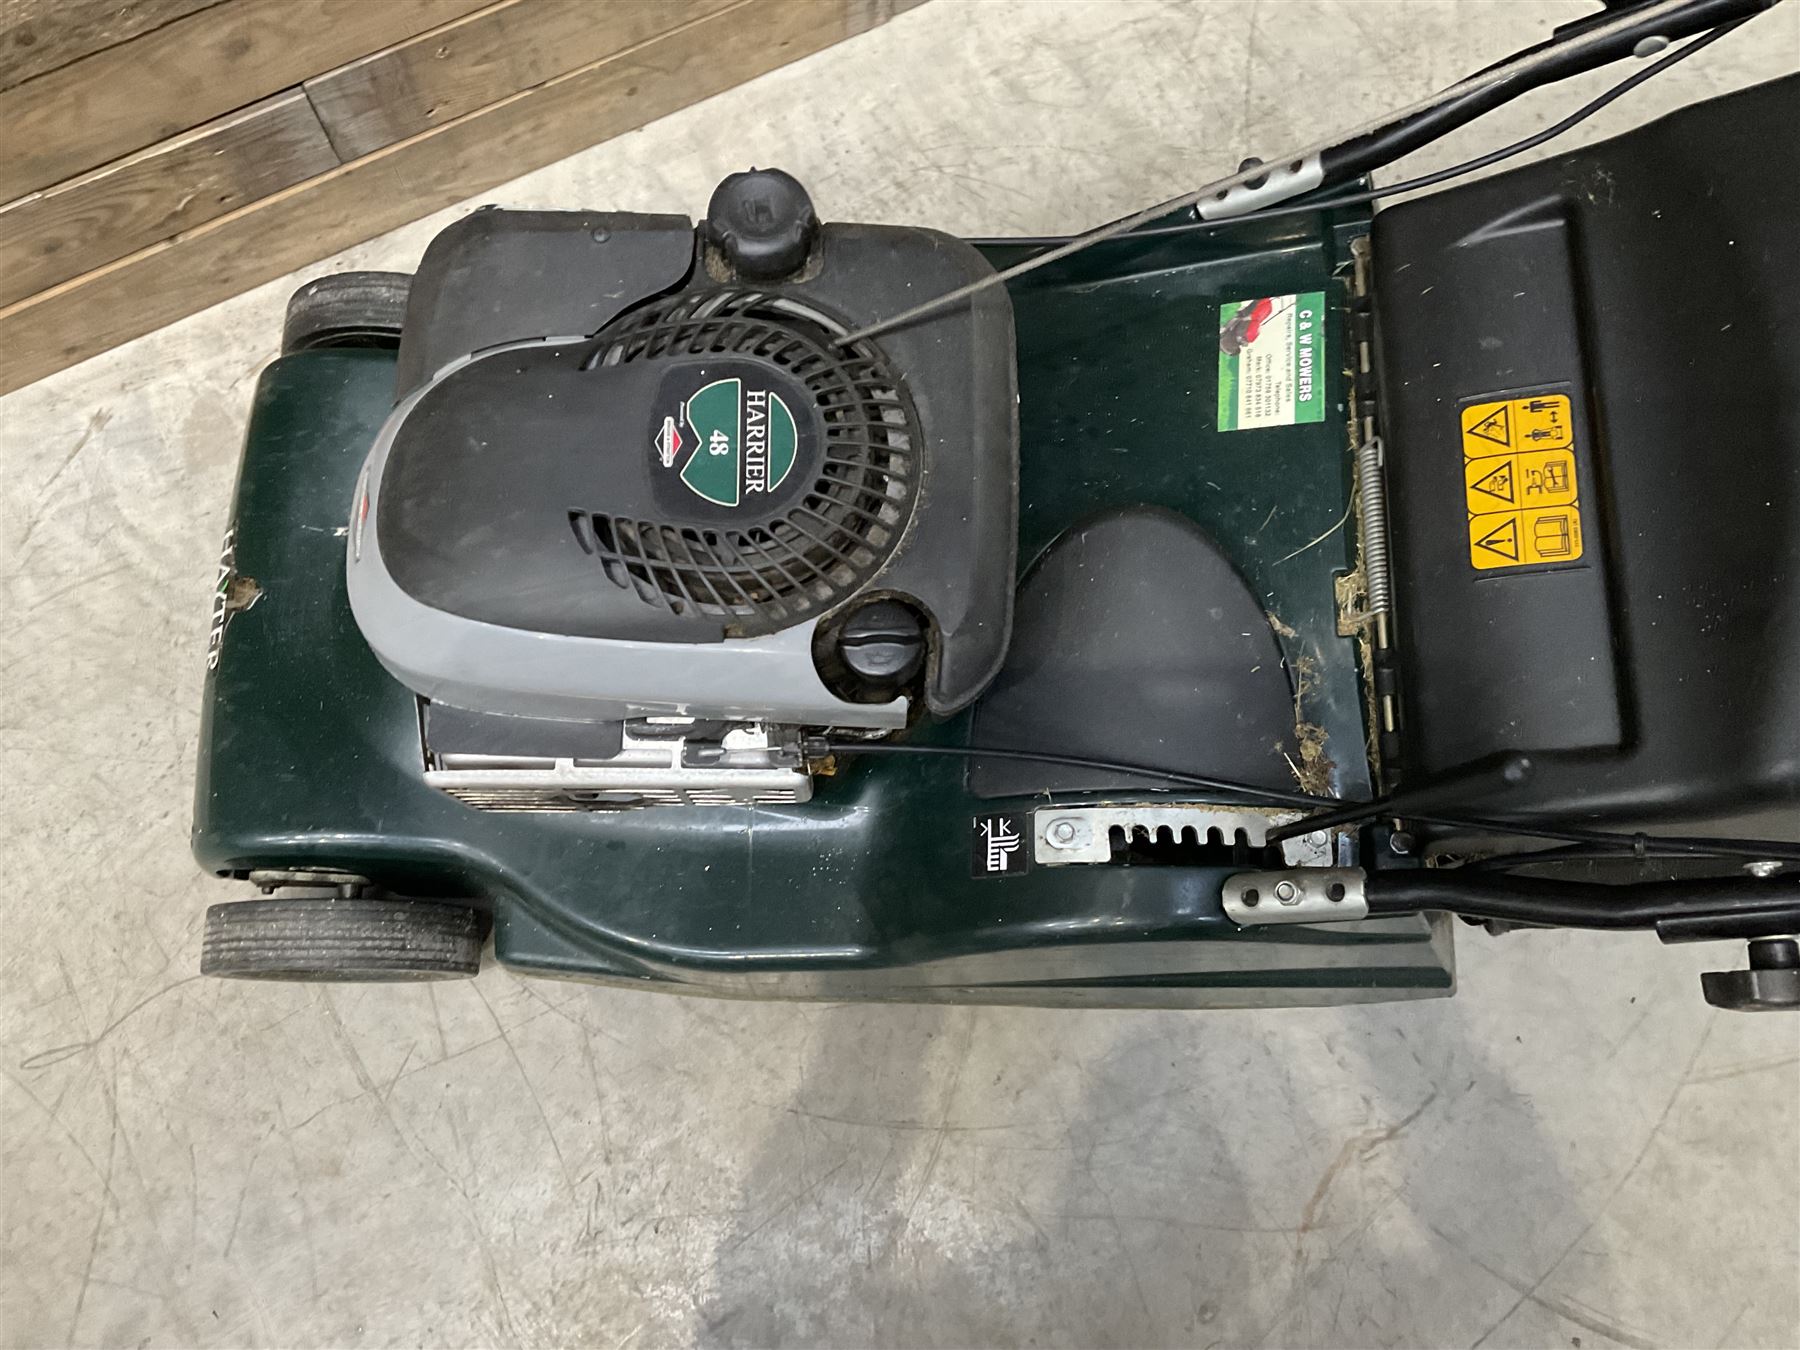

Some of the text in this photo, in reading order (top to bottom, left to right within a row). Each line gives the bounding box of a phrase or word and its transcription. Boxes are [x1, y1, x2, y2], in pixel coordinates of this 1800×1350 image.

[1285, 342, 1293, 367] Service
[1299, 310, 1312, 402] C & W MOWERS
[1285, 383, 1293, 402] Sales
[709, 430, 729, 456] 48
[745, 390, 766, 495] HARRIER
